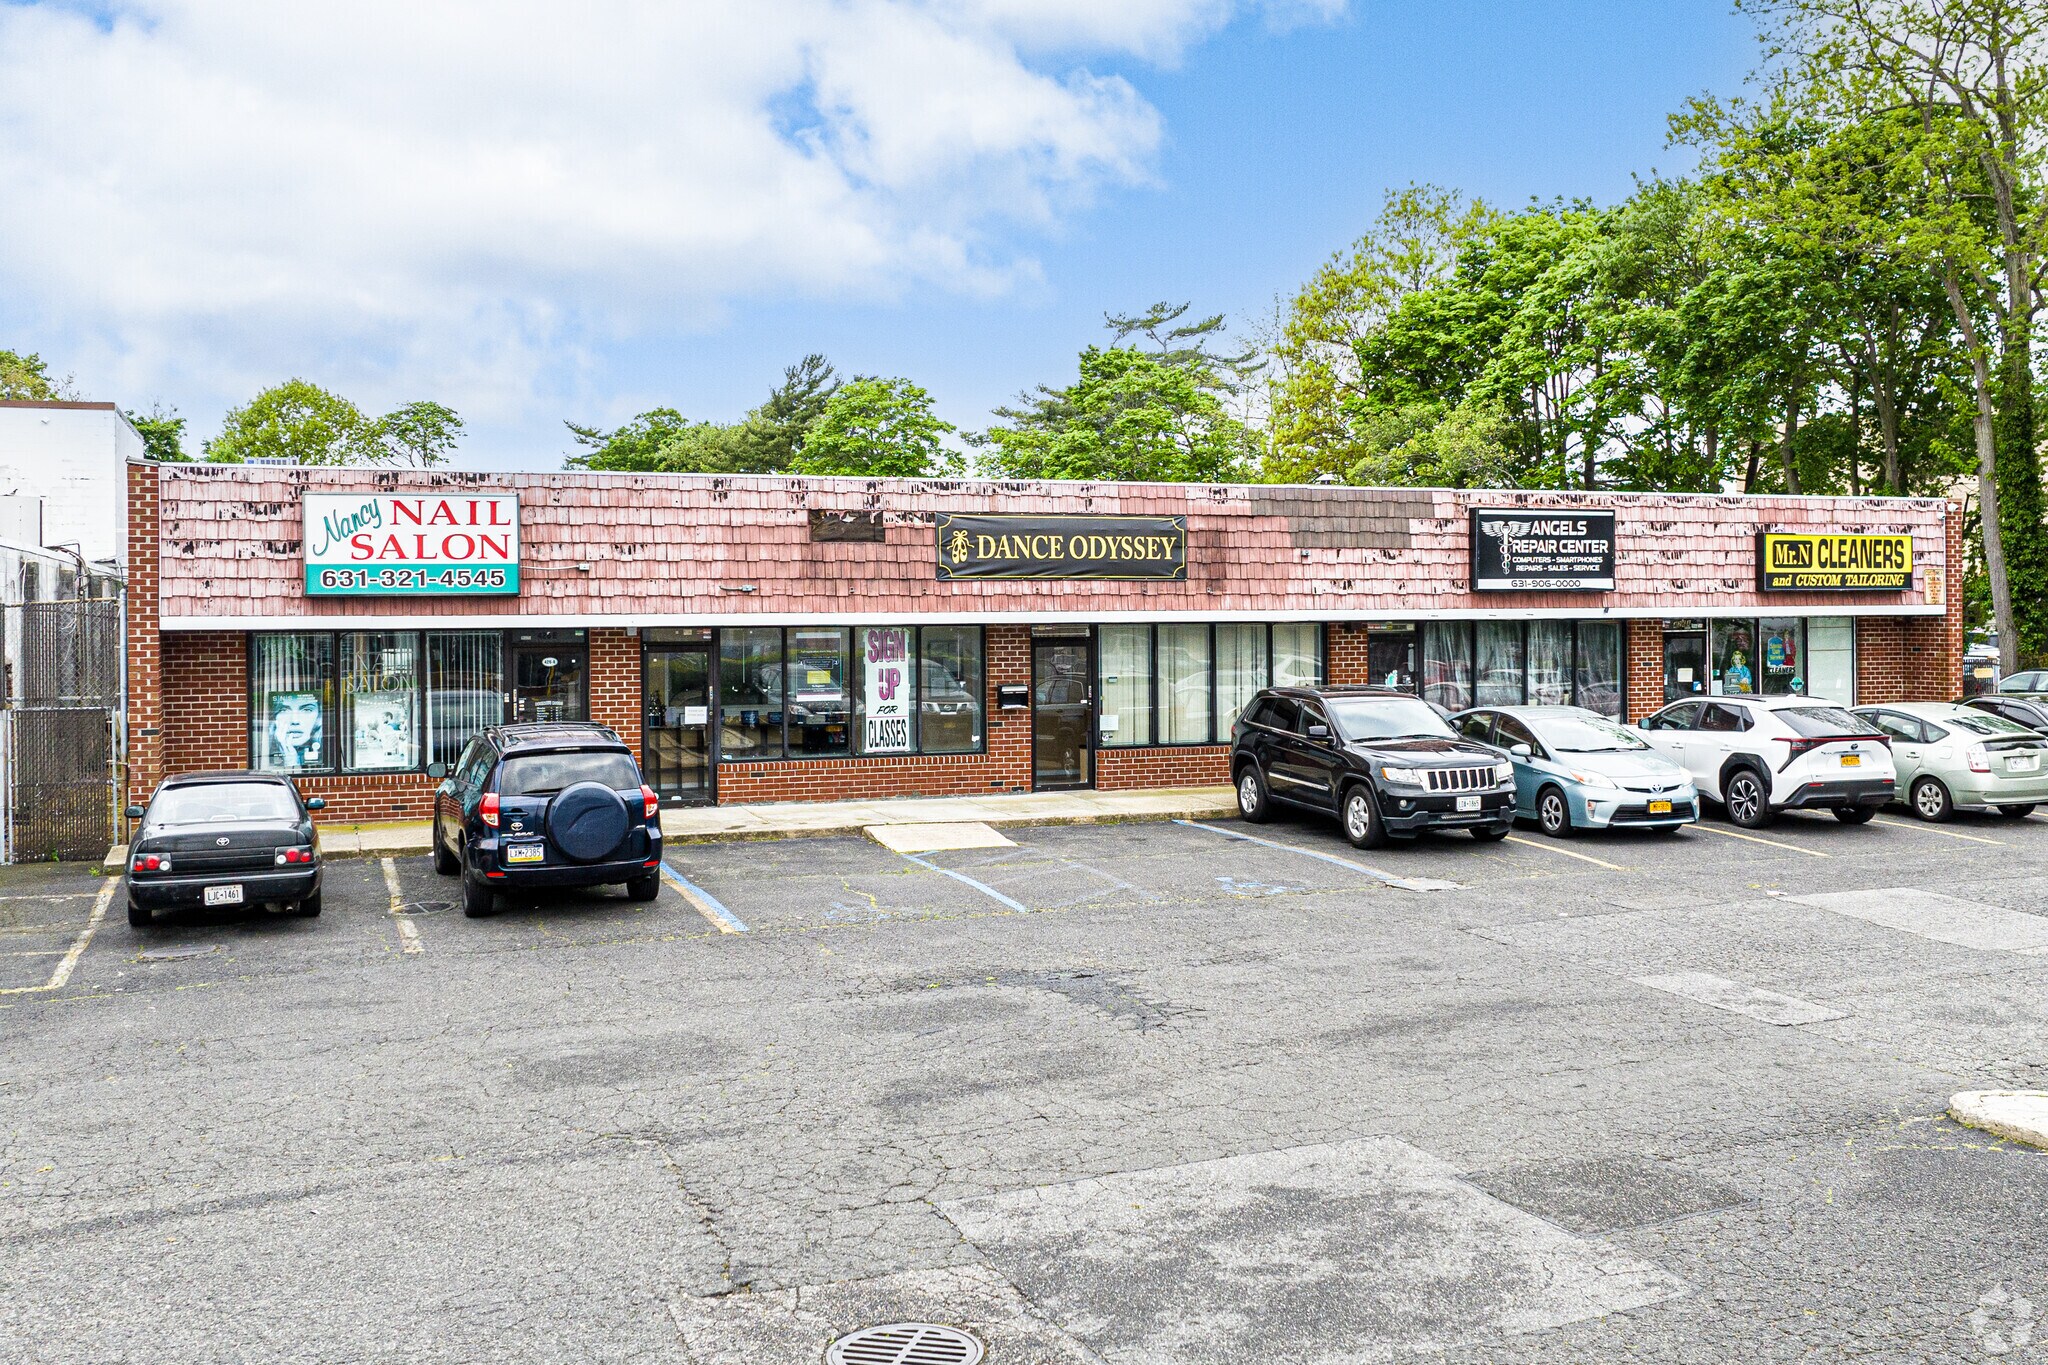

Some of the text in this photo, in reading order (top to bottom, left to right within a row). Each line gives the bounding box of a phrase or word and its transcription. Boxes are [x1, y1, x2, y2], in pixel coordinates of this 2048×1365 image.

[390, 500, 511, 525] NAIL
[313, 498, 382, 556] Nancy
[1530, 520, 1587, 536] ANGELS
[351, 534, 511, 560] SALON
[976, 534, 1177, 561] DANCE ODYSSEY
[1512, 539, 1608, 553] REPAIR CENTER
[1817, 538, 1905, 569] CLEANERS
[1512, 556, 1551, 564] COMPUTERS
[1556, 556, 1603, 564] SMARTPHONES
[321, 569, 505, 588] 631-321-4545
[1511, 579, 1581, 588] 631-906-0000
[1773, 574, 1905, 587] and CUSTOM TAILORING
[867, 628, 906, 663] SIGN
[878, 668, 901, 701] UP
[877, 705, 898, 714] FOR
[868, 718, 907, 748] CLASSES
